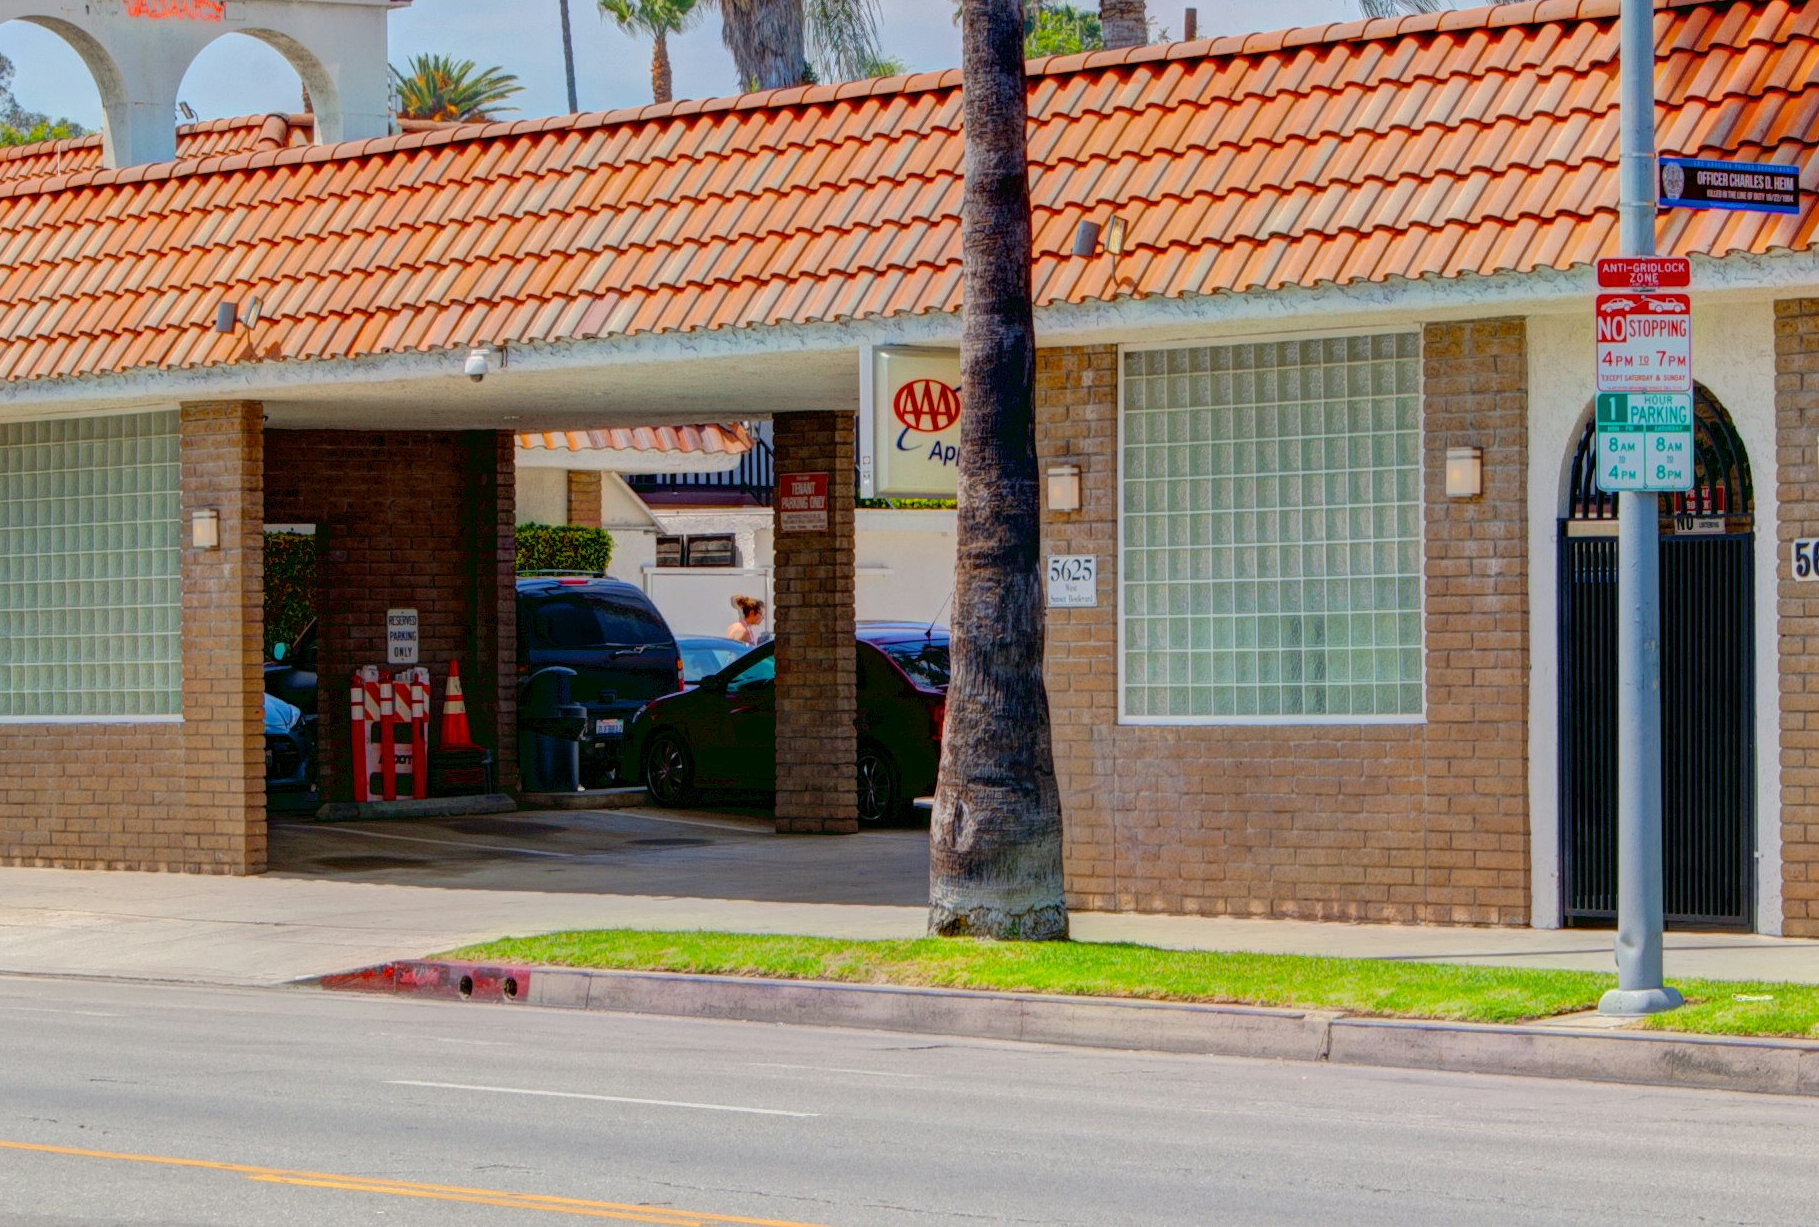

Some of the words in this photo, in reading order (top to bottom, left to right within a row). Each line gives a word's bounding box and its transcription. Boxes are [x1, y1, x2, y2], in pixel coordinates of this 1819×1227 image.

[1696, 170, 1728, 187] OFFICER
[1729, 172, 1764, 190] CHARLES
[1765, 175, 1773, 190] D.
[1774, 176, 1794, 191] HEIM
[1602, 262, 1685, 273] ANTI-GRIDLOCK
[1629, 272, 1658, 283] ZONE
[1598, 315, 1626, 341] NO
[1628, 319, 1686, 338] STOPPING
[1638, 355, 1649, 366] TO
[894, 379, 960, 431] AAA
[1609, 396, 1616, 420] 1
[1644, 395, 1673, 405] HOUR
[1630, 405, 1687, 424] PARKING
[1051, 559, 1092, 582] 5625
[389, 616, 416, 626] RESERVED
[390, 631, 416, 642] PARKING
[394, 647, 412, 658] ONLY
